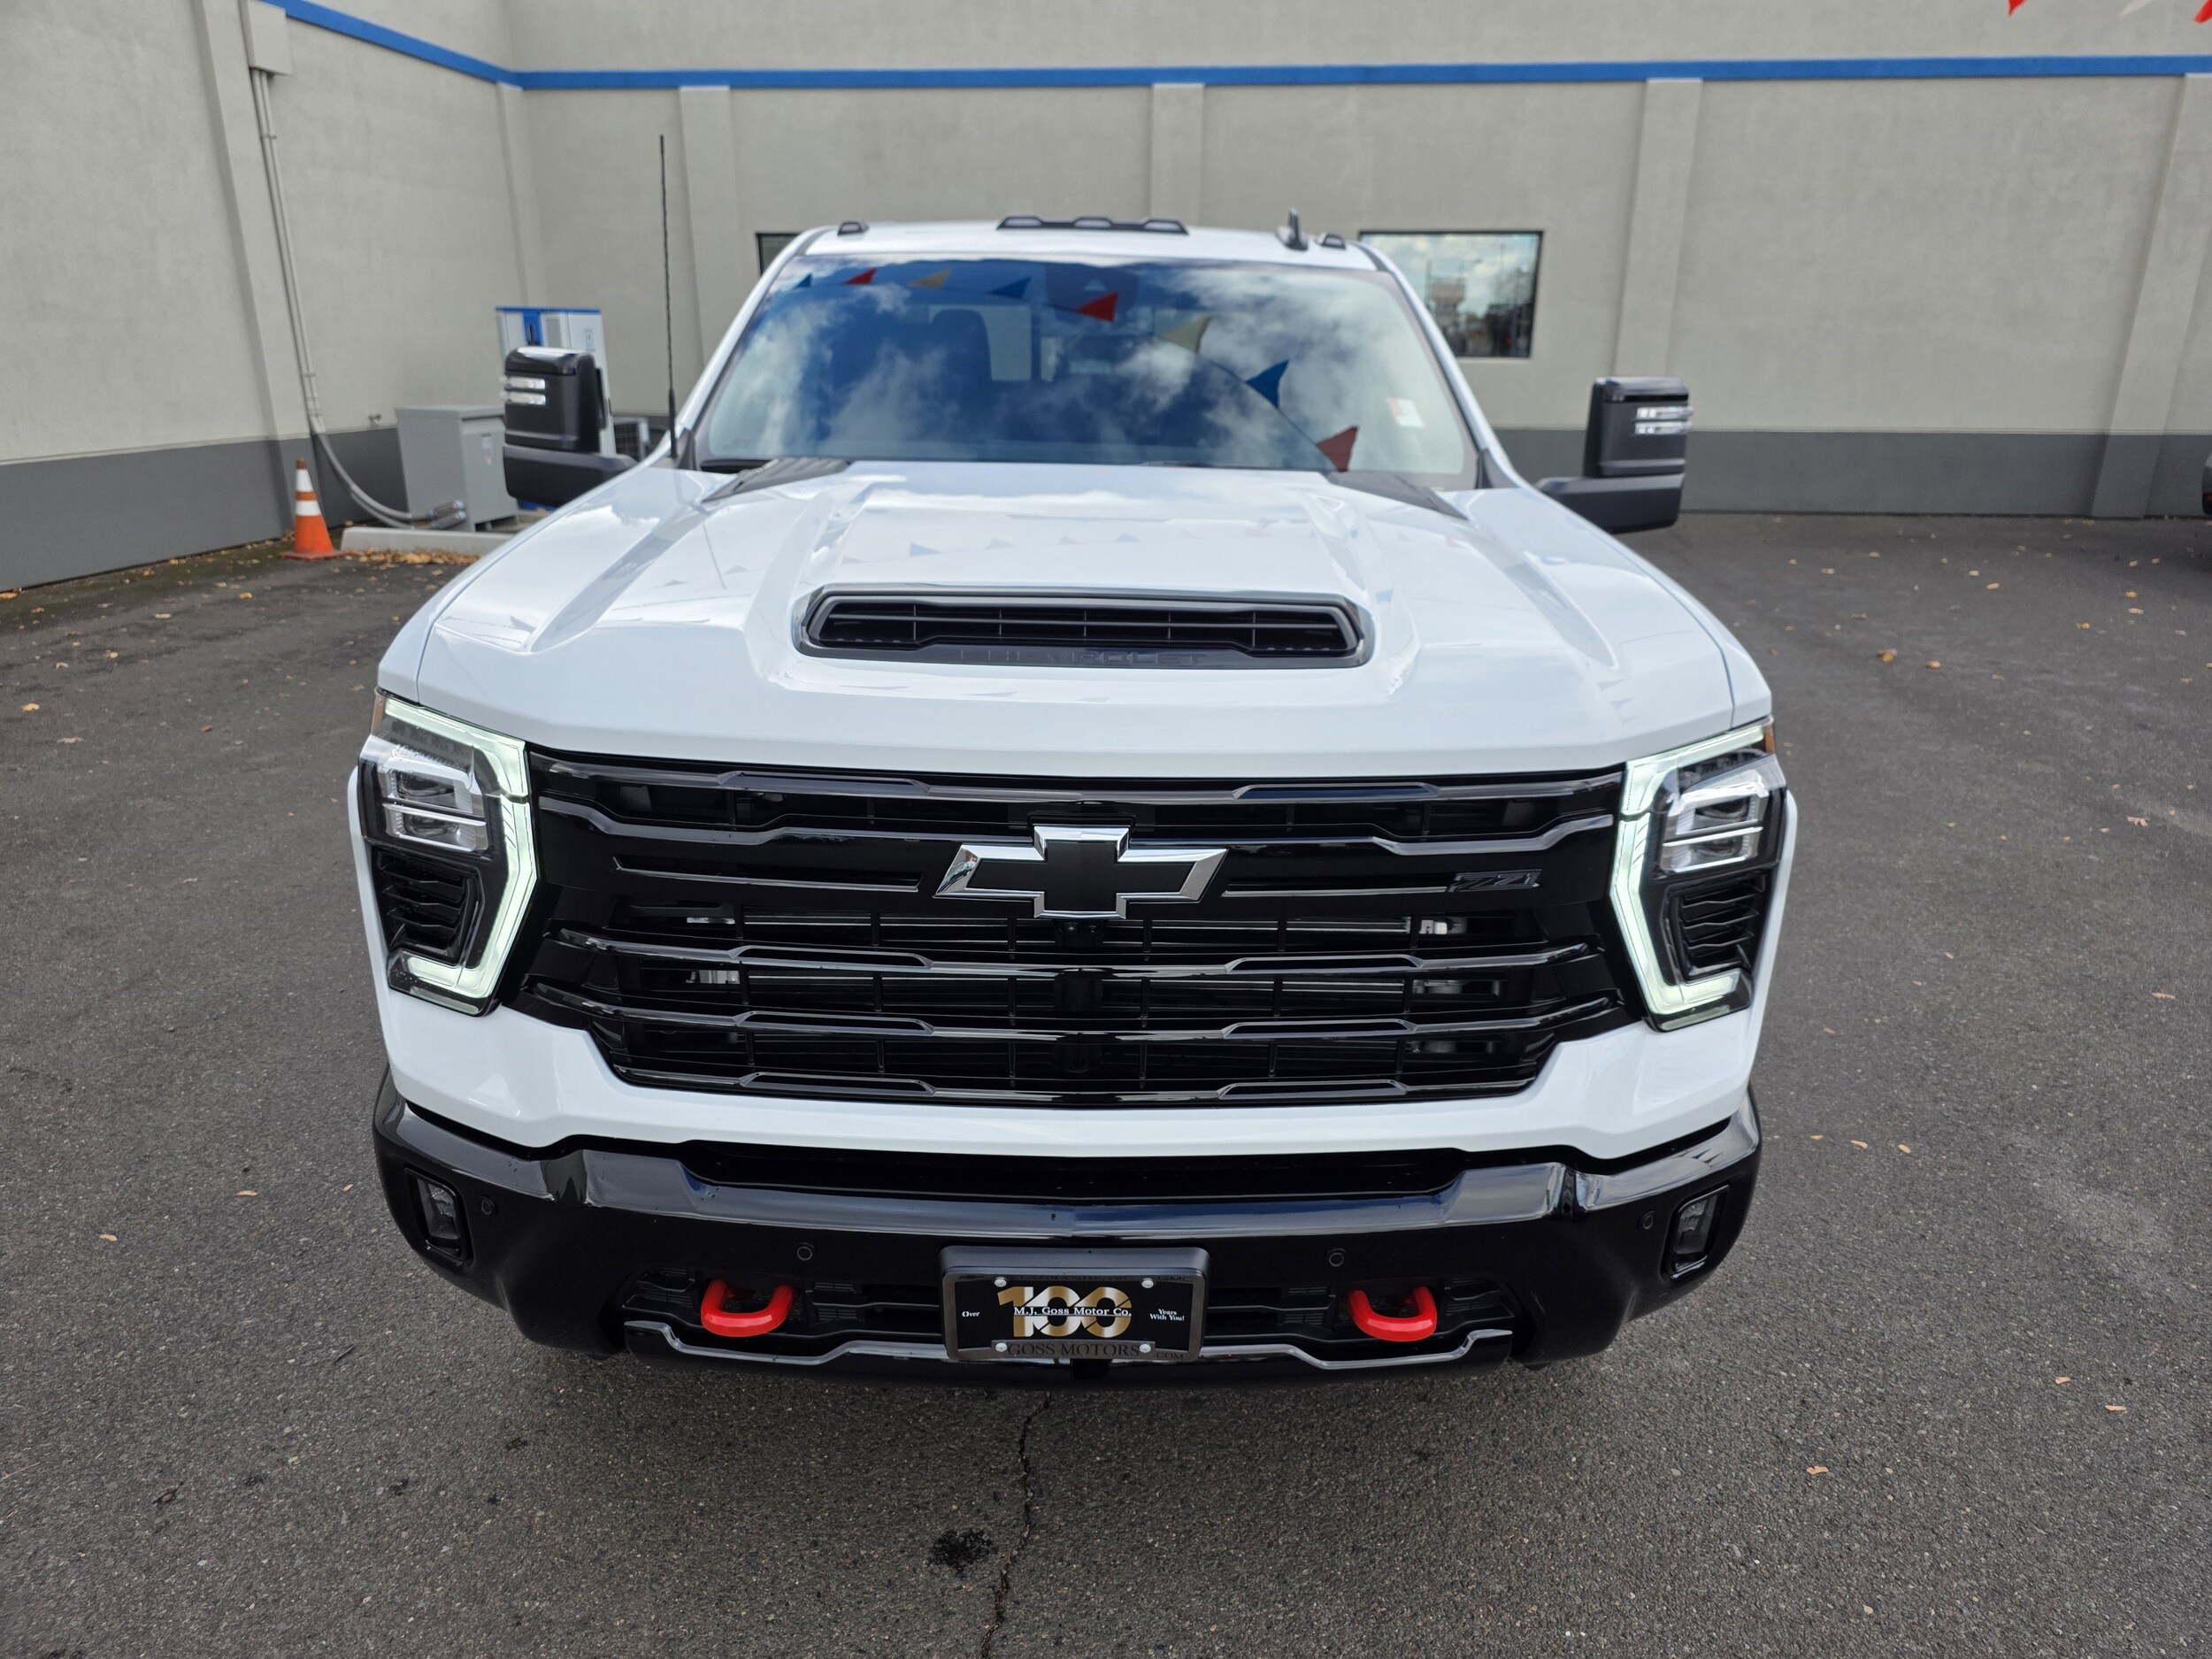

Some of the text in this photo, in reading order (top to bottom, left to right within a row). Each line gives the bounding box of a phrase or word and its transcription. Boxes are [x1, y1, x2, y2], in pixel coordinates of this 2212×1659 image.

[997, 1286, 1132, 1338] 100
[1014, 1307, 1132, 1317] M.J. Goss Motor Co.
[1008, 1343, 1140, 1356] GOSS MOTORS
